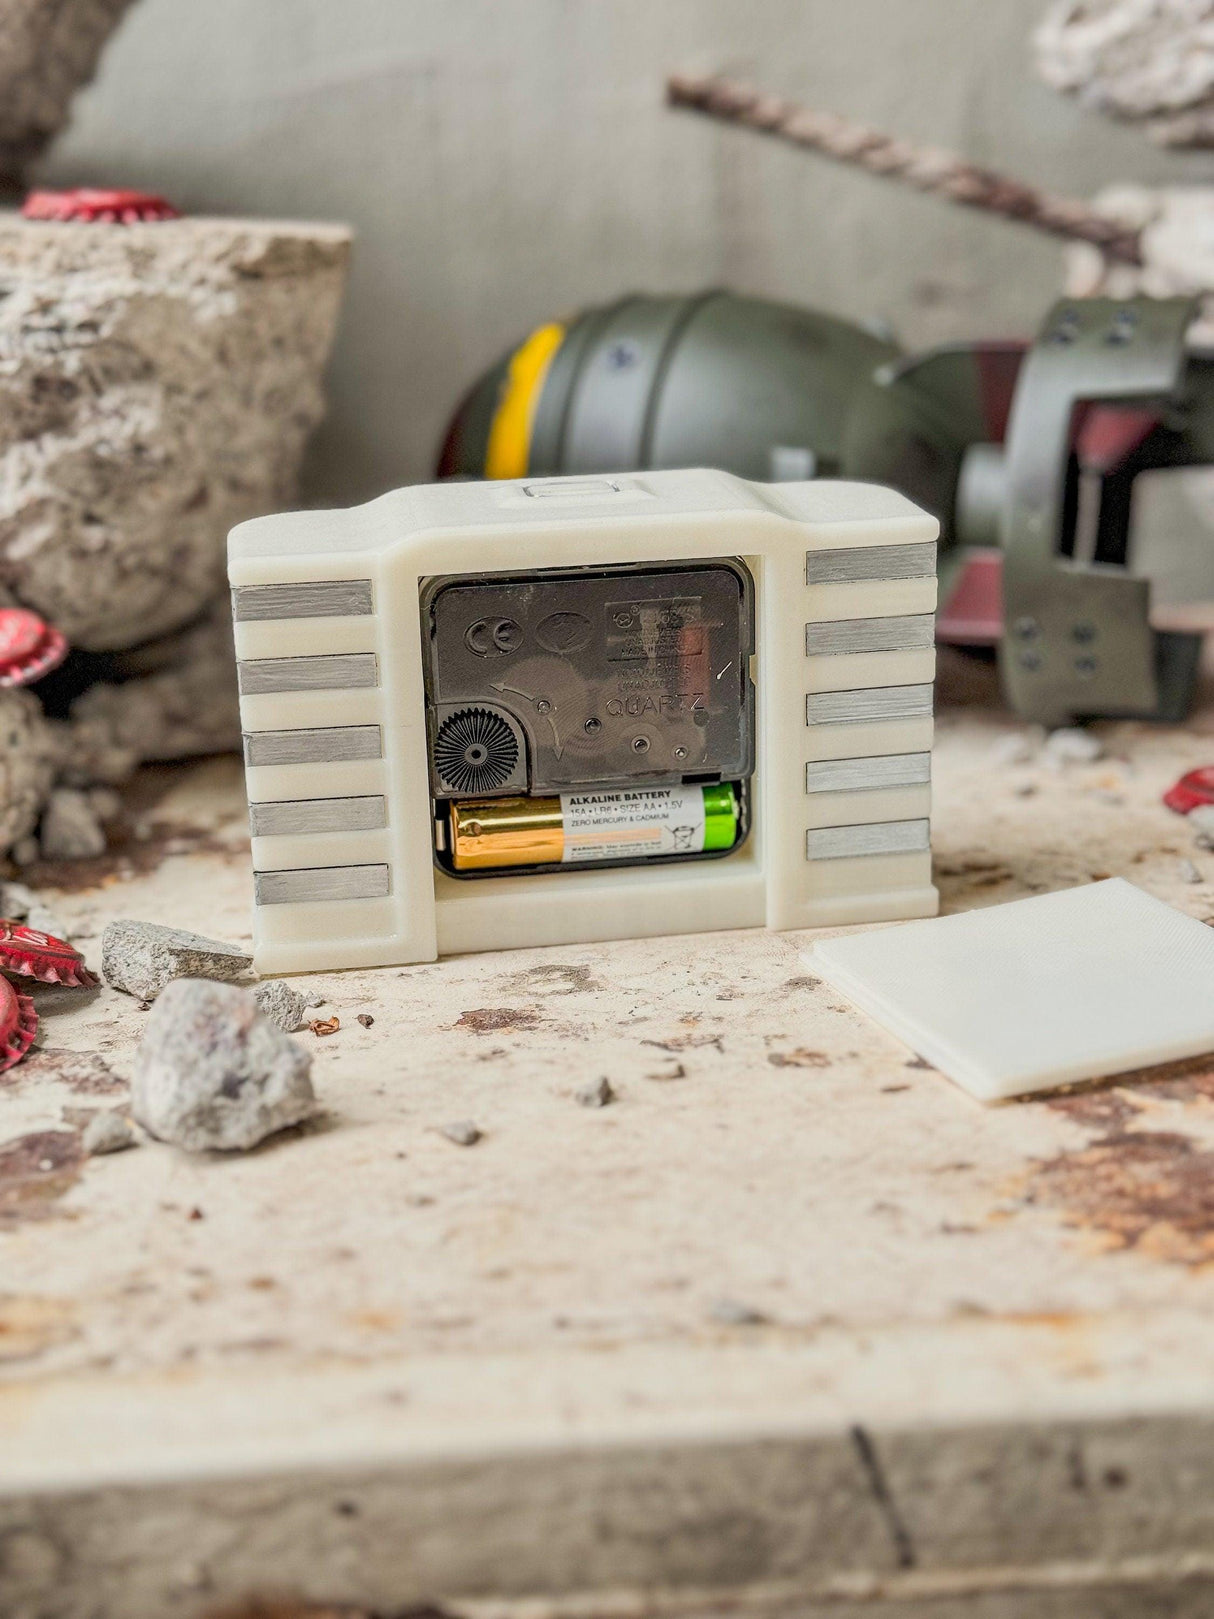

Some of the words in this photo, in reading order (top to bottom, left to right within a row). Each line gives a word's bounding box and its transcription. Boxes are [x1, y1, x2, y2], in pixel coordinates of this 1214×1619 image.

[605, 692, 705, 718] QUARTZ
[569, 794, 622, 806] ALKALINE
[624, 790, 671, 802] BATTERY
[619, 803, 640, 813] SIZE
[643, 802, 656, 812] AA
[664, 799, 683, 809] 1.5V
[571, 818, 591, 827] ZERO
[592, 815, 627, 826] MERCURY
[635, 813, 669, 823] CADMIUM
